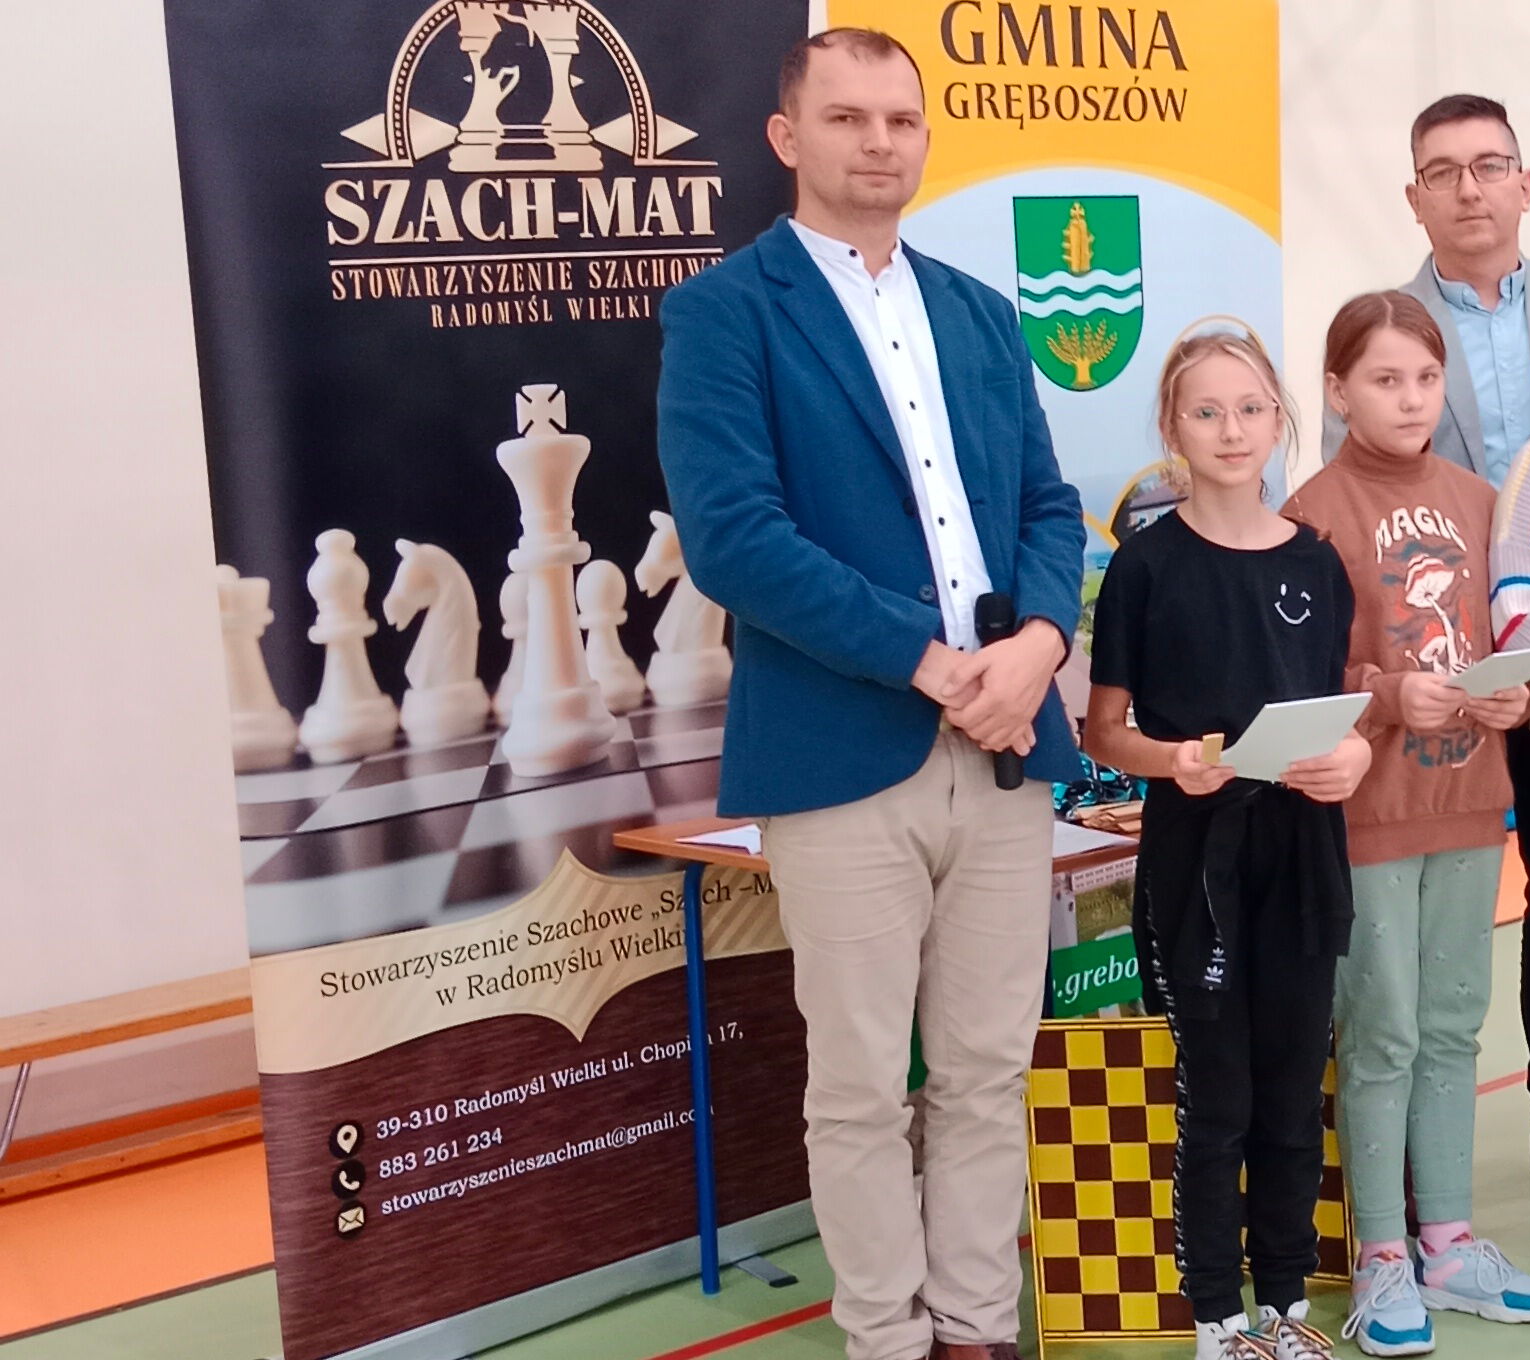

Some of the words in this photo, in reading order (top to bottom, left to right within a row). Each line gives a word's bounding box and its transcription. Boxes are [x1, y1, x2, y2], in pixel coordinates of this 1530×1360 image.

[940, 0, 1189, 72] GMINA
[943, 76, 1188, 130] GRĘBOSZÓW
[324, 175, 723, 246] SZACH-MAT
[331, 260, 573, 301] STOWARZYSZENIE
[431, 294, 553, 328] RADOMYŚL
[566, 295, 650, 321] WIELKI
[1375, 506, 1467, 564] MAGIC
[319, 929, 519, 998] Stowarzyszenie
[527, 902, 643, 947] Szachowe
[651, 880, 732, 921] „Szch
[436, 986, 457, 1007] w
[467, 946, 603, 1000] Radomyślu
[610, 923, 687, 962] Wielki
[376, 1104, 448, 1139] 39-310
[454, 1075, 546, 1118] Radomyśl
[551, 1062, 607, 1090] Wielki
[611, 1051, 634, 1072] ul.
[640, 1033, 714, 1063] Chopi
[719, 1022, 743, 1042] 17,
[379, 1154, 418, 1179] 883
[423, 1141, 460, 1167] 261
[467, 1127, 503, 1153] 234
[381, 1104, 714, 1216] stowarzyszenieszachmat@gmail.co
